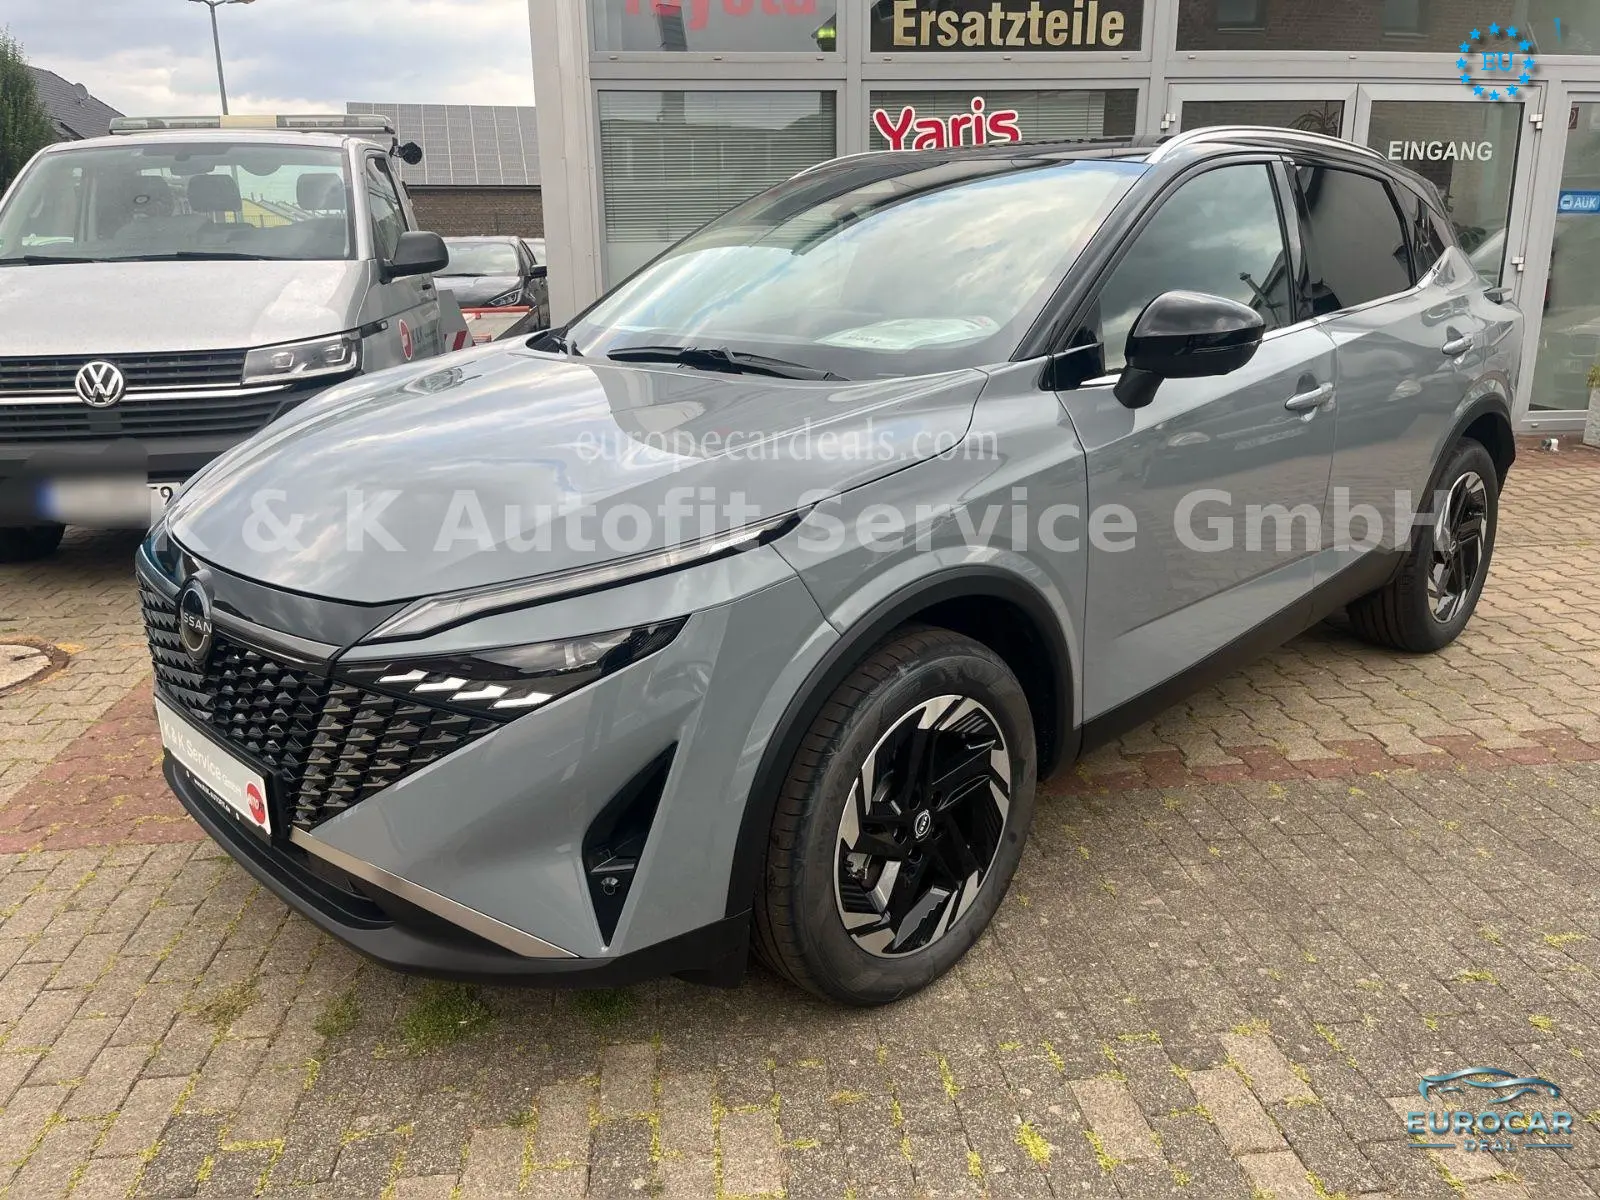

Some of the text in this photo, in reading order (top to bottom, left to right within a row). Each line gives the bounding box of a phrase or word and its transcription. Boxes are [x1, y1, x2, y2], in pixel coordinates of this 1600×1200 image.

[893, 0, 1125, 46] Ersatzteile
[873, 96, 1022, 151] Yaris
[1388, 140, 1493, 161] EINGANG
[183, 612, 212, 634] SSAN
